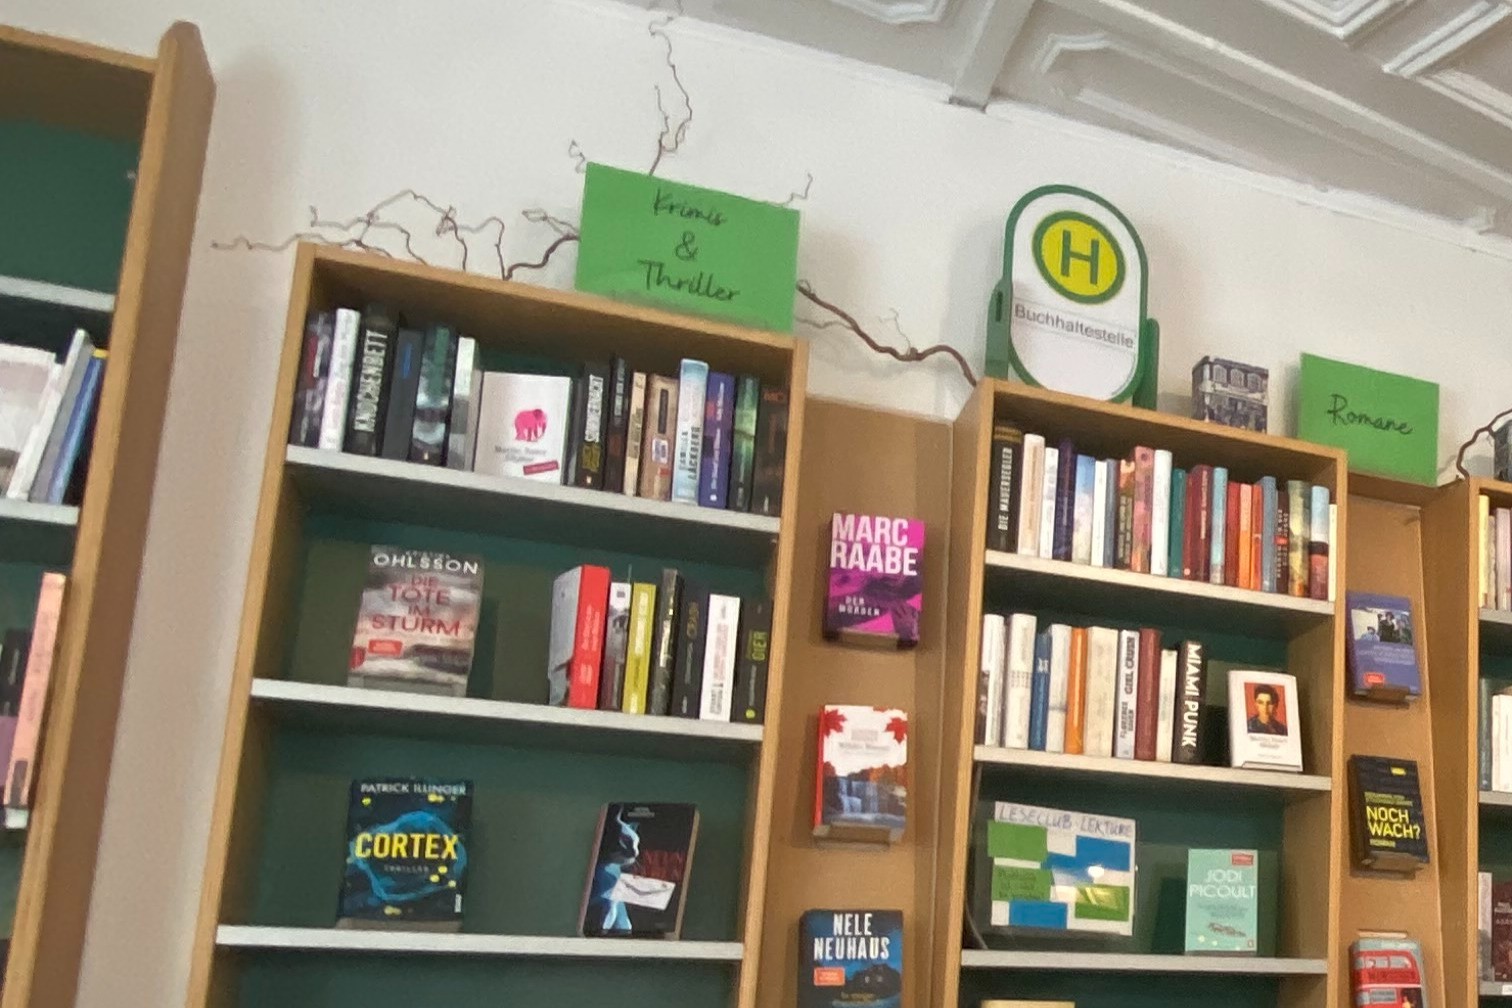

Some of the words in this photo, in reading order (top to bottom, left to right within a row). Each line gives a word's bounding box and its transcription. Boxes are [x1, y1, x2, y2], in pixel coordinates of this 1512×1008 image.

[653, 187, 727, 226] Krimis
[675, 230, 699, 262] &
[1060, 229, 1100, 285] H
[637, 258, 741, 301] Thriller
[1014, 303, 1135, 349] Buchhaltestelle
[353, 329, 388, 433] KNOCHENBETT
[1327, 393, 1413, 436] Romane
[832, 512, 909, 547] MARC
[373, 553, 478, 575] OHLSSON
[829, 539, 919, 576] RAABE
[411, 575, 439, 587] DIE
[389, 583, 450, 605] TOTE
[408, 604, 431, 616] IM
[371, 613, 461, 636] STURM
[1184, 643, 1202, 699] MIAMI
[1181, 700, 1200, 748] PUNK
[360, 782, 409, 794] PATRICK
[999, 805, 1073, 830] LESECLUB
[1365, 805, 1409, 825] NOCH
[1366, 821, 1421, 841] WACH?
[354, 831, 458, 862] CORTEX
[1205, 868, 1242, 883] JODI
[1189, 884, 1257, 899] PICOULT
[833, 913, 873, 936] NELE
[813, 937, 891, 961] NEUHAUS
